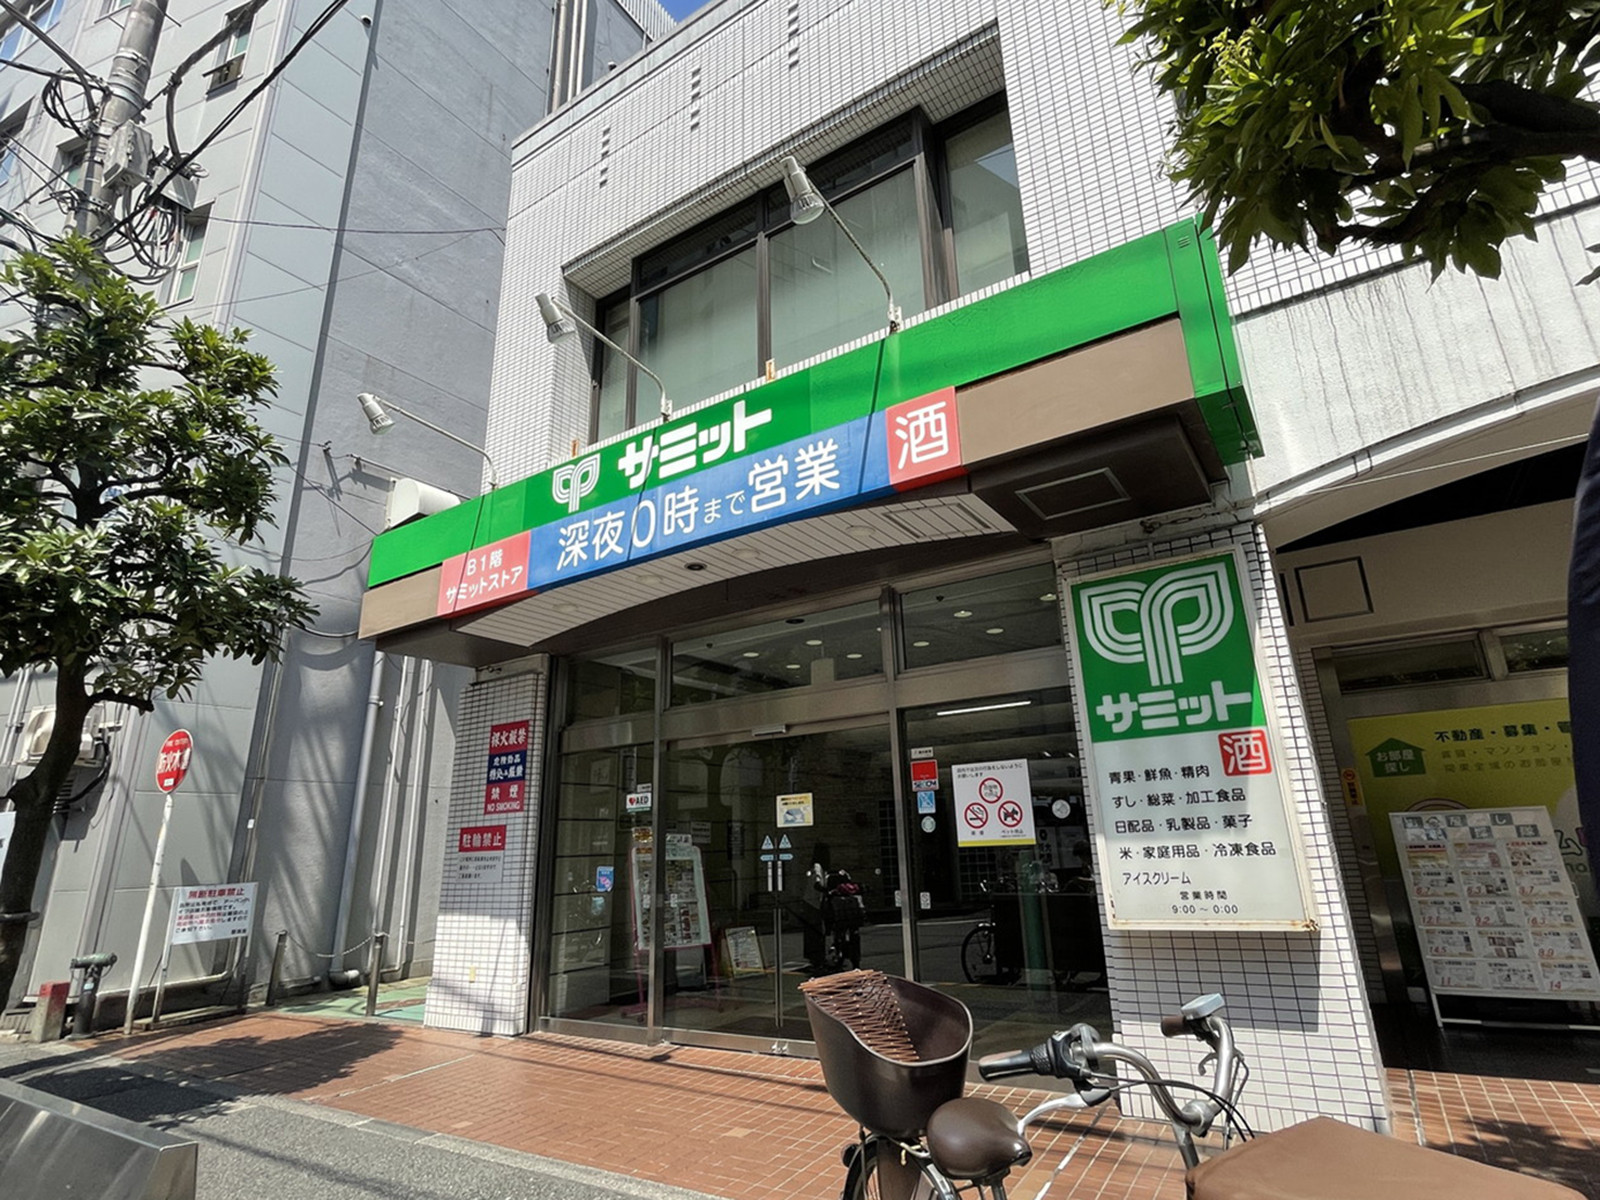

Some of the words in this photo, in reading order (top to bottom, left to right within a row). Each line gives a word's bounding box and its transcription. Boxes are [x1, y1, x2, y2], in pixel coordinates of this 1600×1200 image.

[618, 399, 773, 490] サミット
[894, 401, 948, 470] 酒
[466, 549, 503, 576] B1階
[446, 566, 523, 604] サミットストア
[1096, 681, 1252, 733] サミット
[1221, 732, 1268, 774] 酒
[487, 803, 495, 812] NO
[496, 801, 520, 811] SMOKING
[636, 795, 650, 805] AED
[1123, 871, 1191, 885] アイスクリーム
[1180, 890, 1227, 900] 営業時間
[1172, 905, 1196, 914] 9:00
[1213, 905, 1239, 914] 0:00
